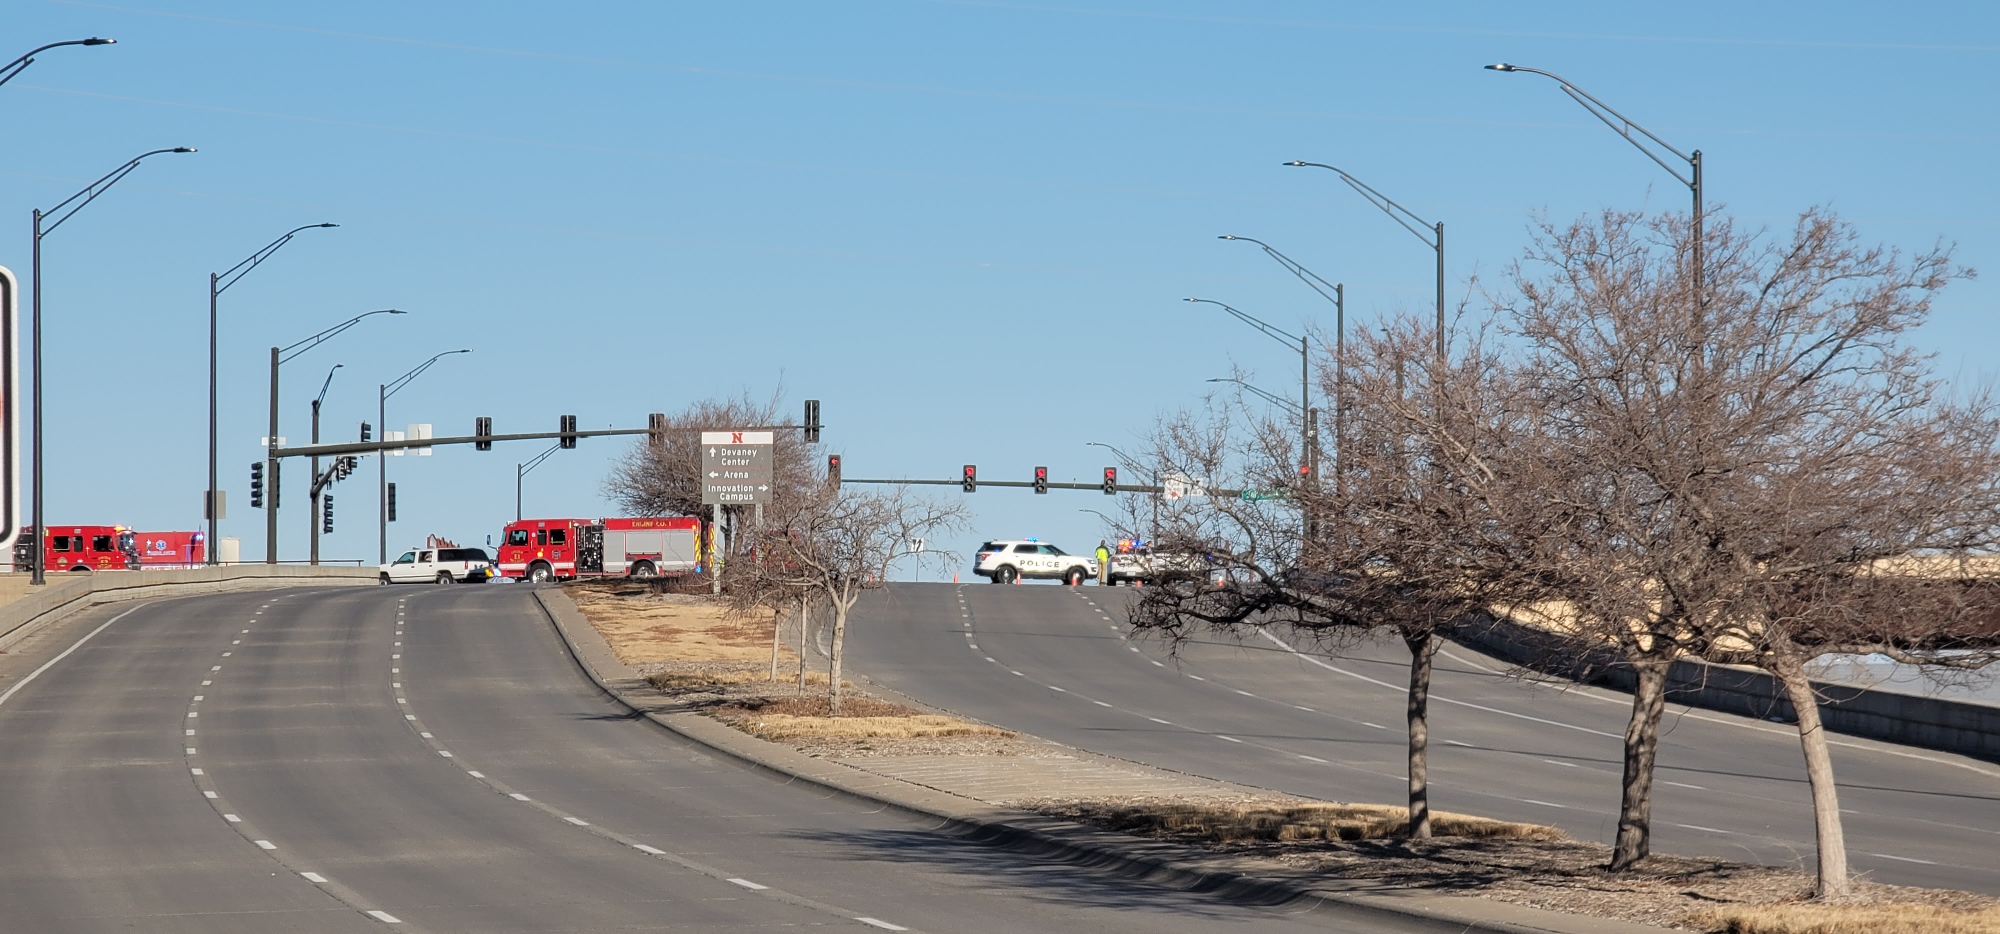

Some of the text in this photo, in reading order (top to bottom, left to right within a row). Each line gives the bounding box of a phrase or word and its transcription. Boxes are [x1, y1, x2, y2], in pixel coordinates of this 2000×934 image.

[732, 433, 743, 443] N
[721, 448, 757, 457] Devaney
[721, 458, 750, 466] Center
[723, 471, 749, 479] Arena
[708, 484, 754, 492] Innovation
[720, 492, 754, 501] Campus
[1020, 560, 1060, 568] POLICE
